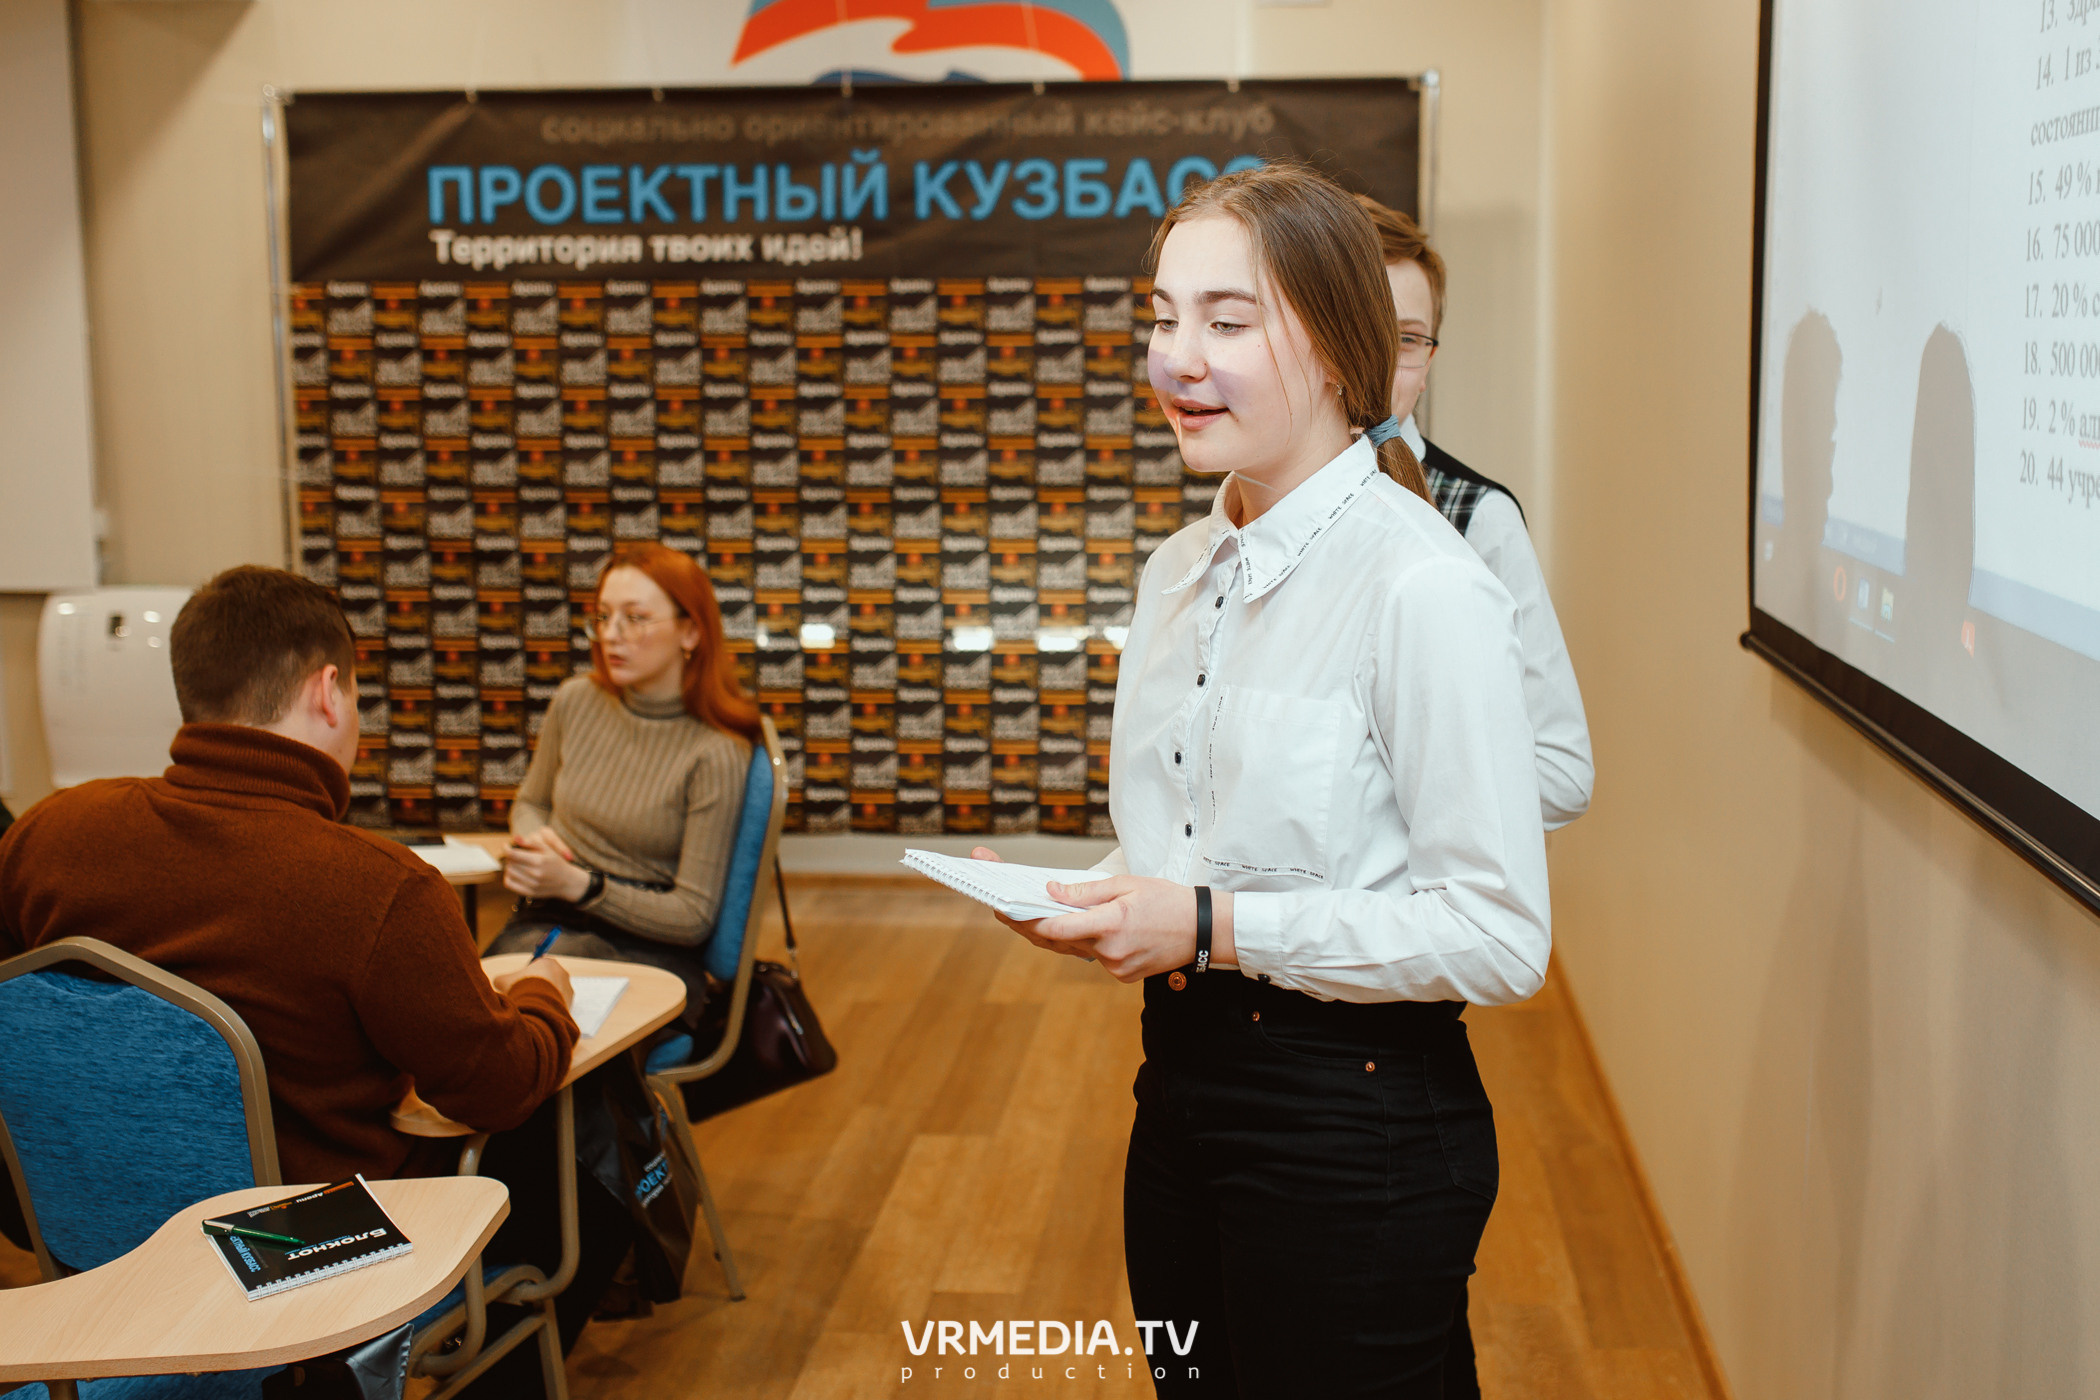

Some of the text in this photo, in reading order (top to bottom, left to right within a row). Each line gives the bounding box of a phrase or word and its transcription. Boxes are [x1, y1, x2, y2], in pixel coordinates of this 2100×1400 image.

[2036, 53, 2054, 90] 14.
[2064, 44, 2070, 81] 1
[2074, 47, 2092, 78] из
[541, 113, 736, 146] социально
[1083, 101, 1276, 142] кейс-клуб
[427, 147, 1265, 225] ПРОЕКТНЫЙ КУЗБАС
[2028, 170, 2045, 205] 15.
[2055, 164, 2072, 200] 49
[2077, 160, 2092, 197] %
[429, 226, 864, 271] Территория твоих идей!
[2026, 226, 2044, 262] 16.
[2053, 222, 2069, 259] 75
[2025, 283, 2042, 319] 17.
[2051, 282, 2069, 319] 20
[2073, 281, 2088, 319] %
[2024, 341, 2041, 375] 18.
[2050, 341, 2075, 377] 500
[2022, 397, 2040, 432] 19.
[2048, 400, 2056, 434] 2
[2060, 401, 2075, 437] %
[2020, 449, 2039, 487] 20.
[2047, 456, 2064, 492] 44
[1327, 505, 1342, 520] WHITE
[1241, 864, 1258, 873] WHITE
[1289, 867, 1307, 875] WHITE
[1309, 871, 1325, 880] SPACE
